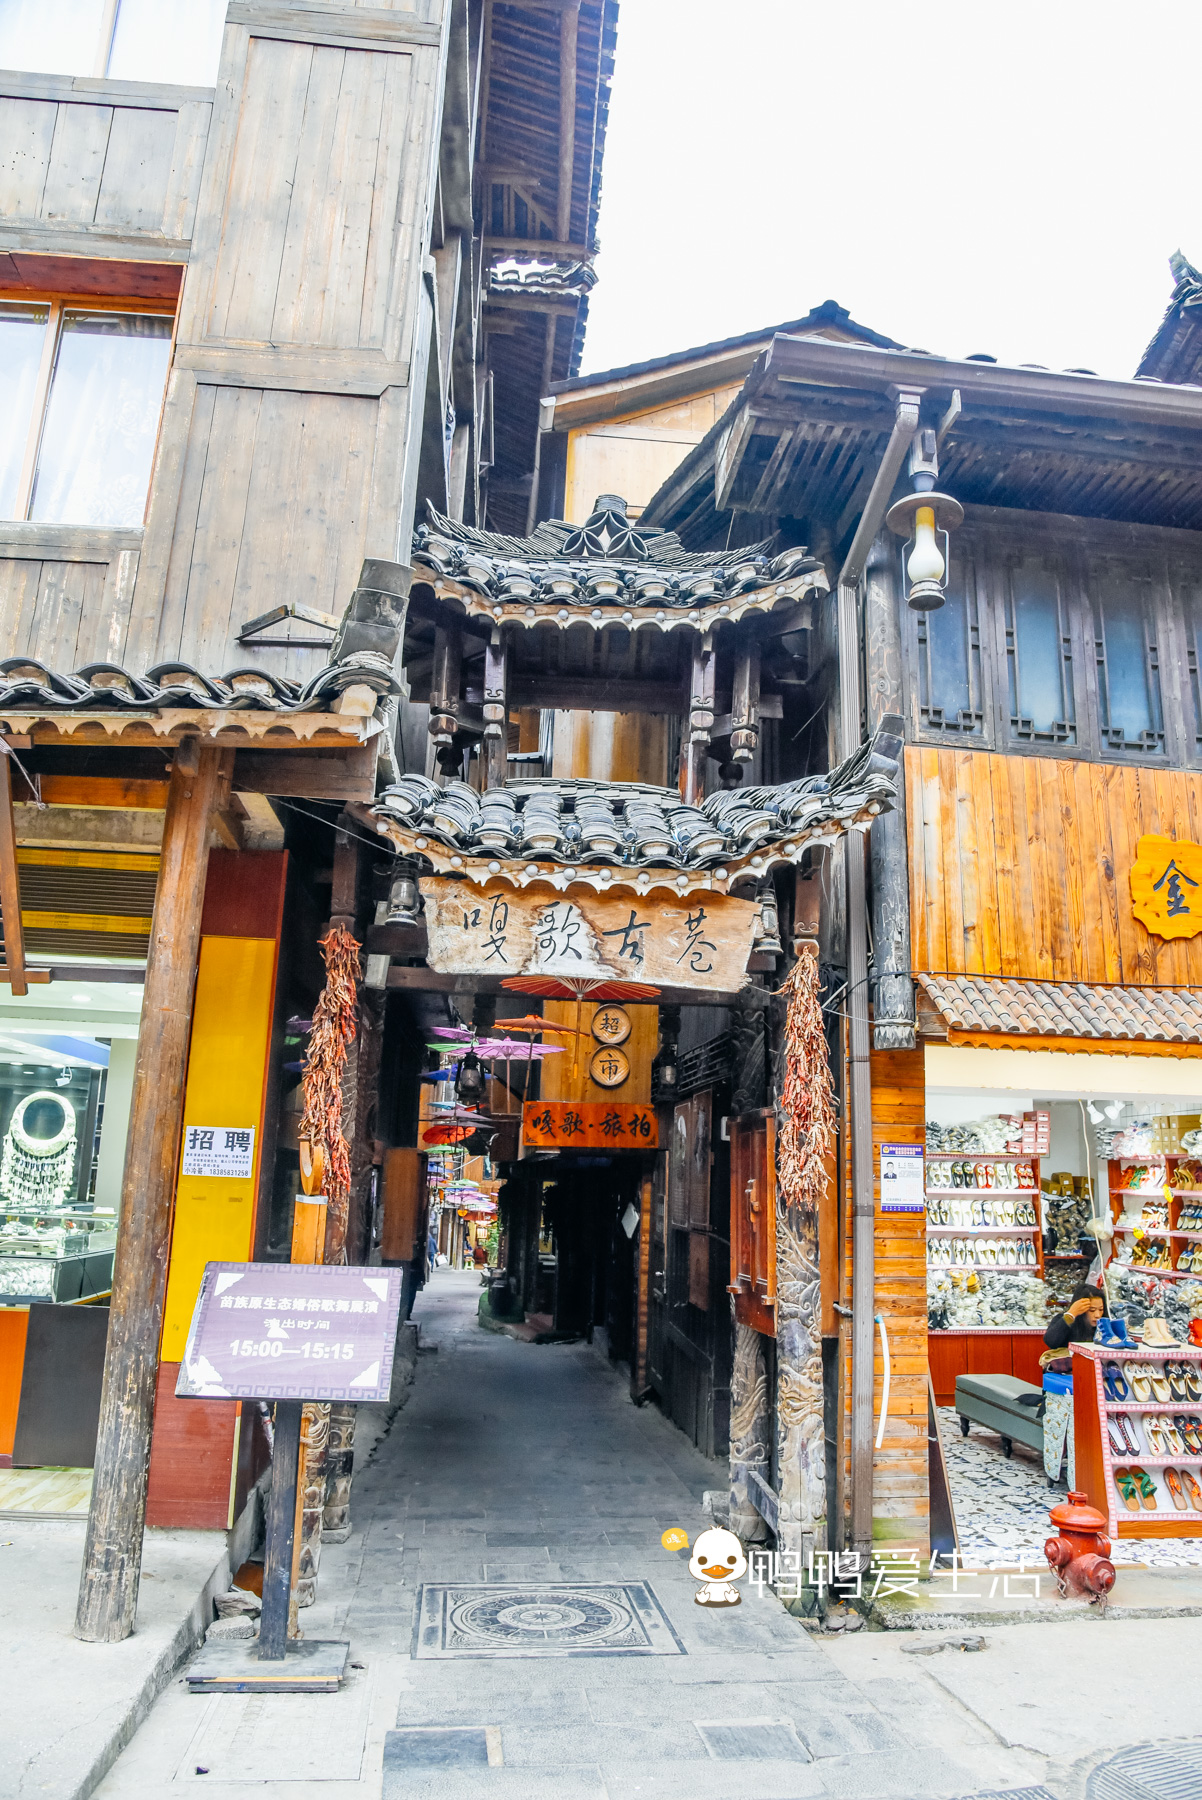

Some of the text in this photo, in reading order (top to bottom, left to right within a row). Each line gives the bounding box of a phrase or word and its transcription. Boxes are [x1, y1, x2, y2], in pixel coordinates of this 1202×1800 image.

[1153, 859, 1199, 917] 金
[599, 1013, 620, 1081] 超市
[189, 1129, 251, 1153] 招聘
[220, 1295, 379, 1314] 苗族原生态婚俗歌舞展演
[263, 1318, 331, 1331] 演出时间
